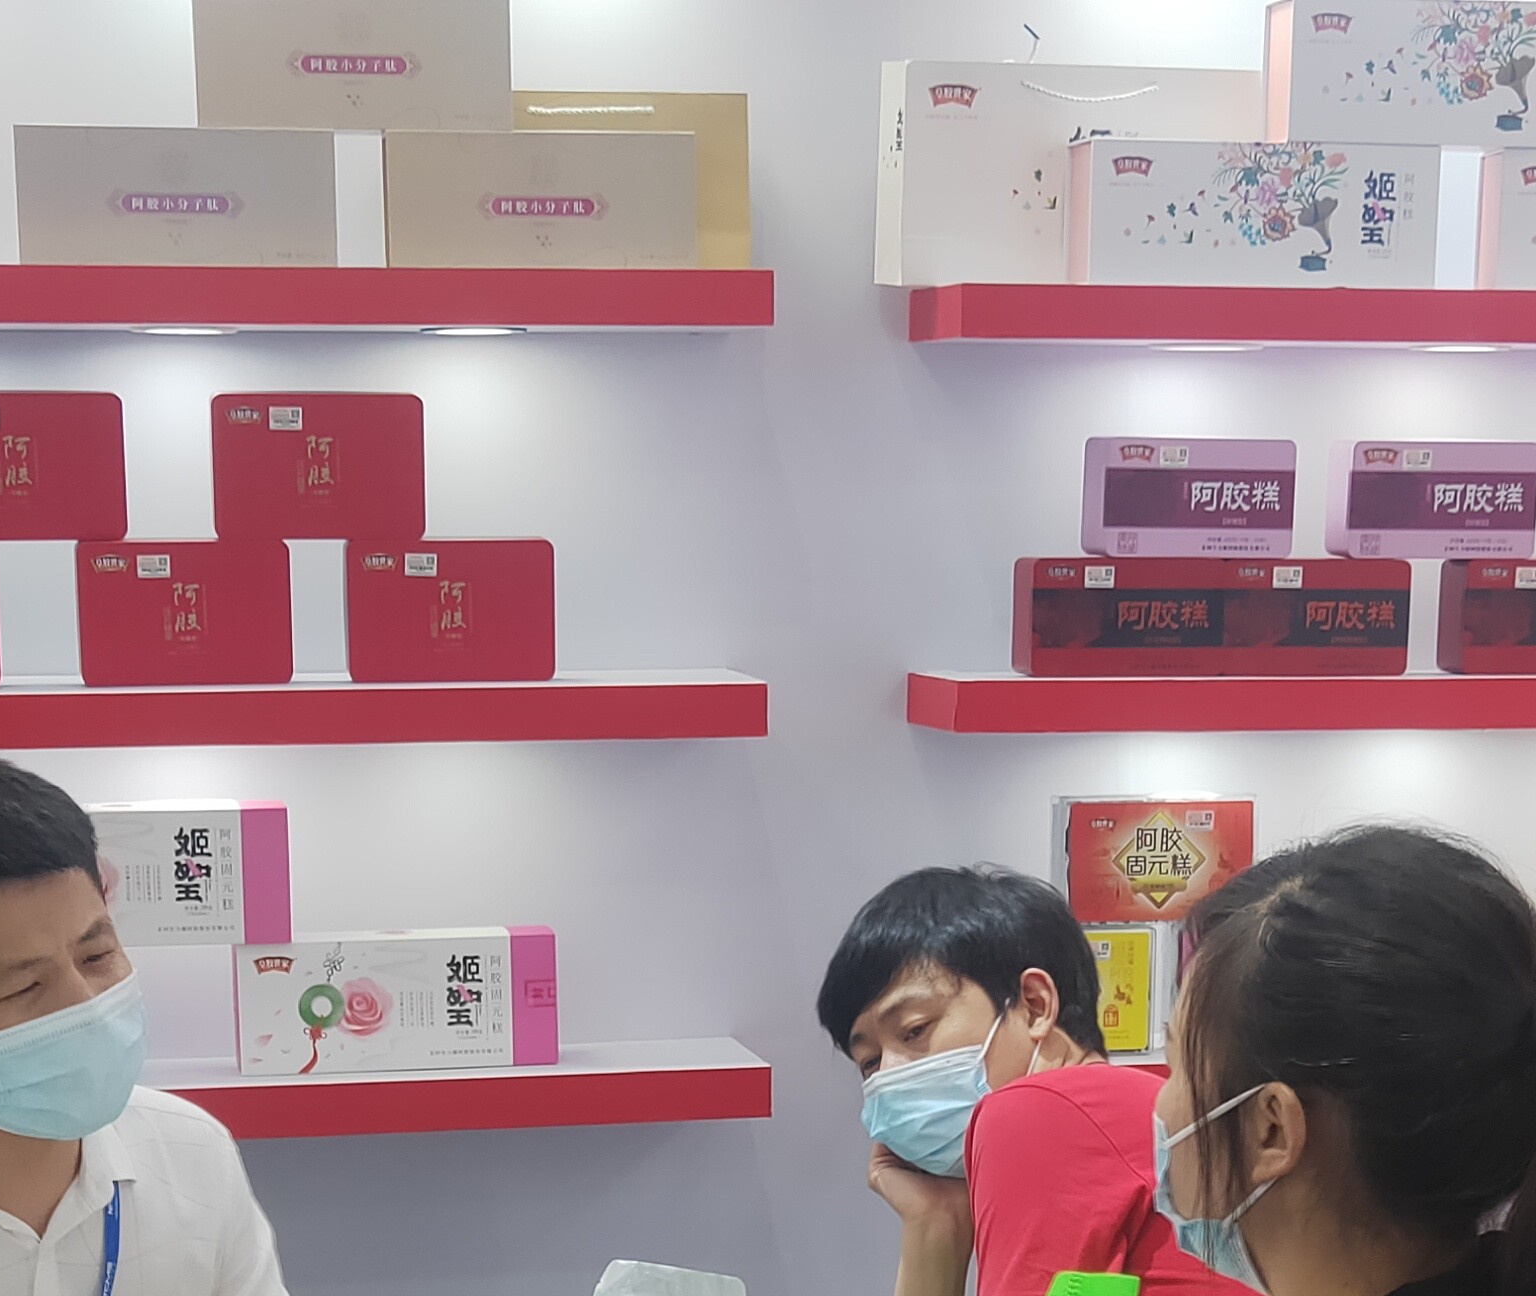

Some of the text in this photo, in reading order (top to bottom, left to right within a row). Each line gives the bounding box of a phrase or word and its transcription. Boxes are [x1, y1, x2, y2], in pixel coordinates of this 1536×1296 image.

[310, 58, 396, 73] 阿胶小分子肽
[132, 197, 219, 213] 阿胶小分子肽
[501, 200, 585, 215] 阿胶小分子肽
[1190, 480, 1281, 512] 阿胶糕
[1434, 482, 1523, 513] 阿胶糕
[1117, 600, 1210, 630] 阿胶糕
[1305, 600, 1396, 630] 阿胶糕
[1136, 826, 1183, 853] 阿胶
[1126, 855, 1194, 877] 固元糕
